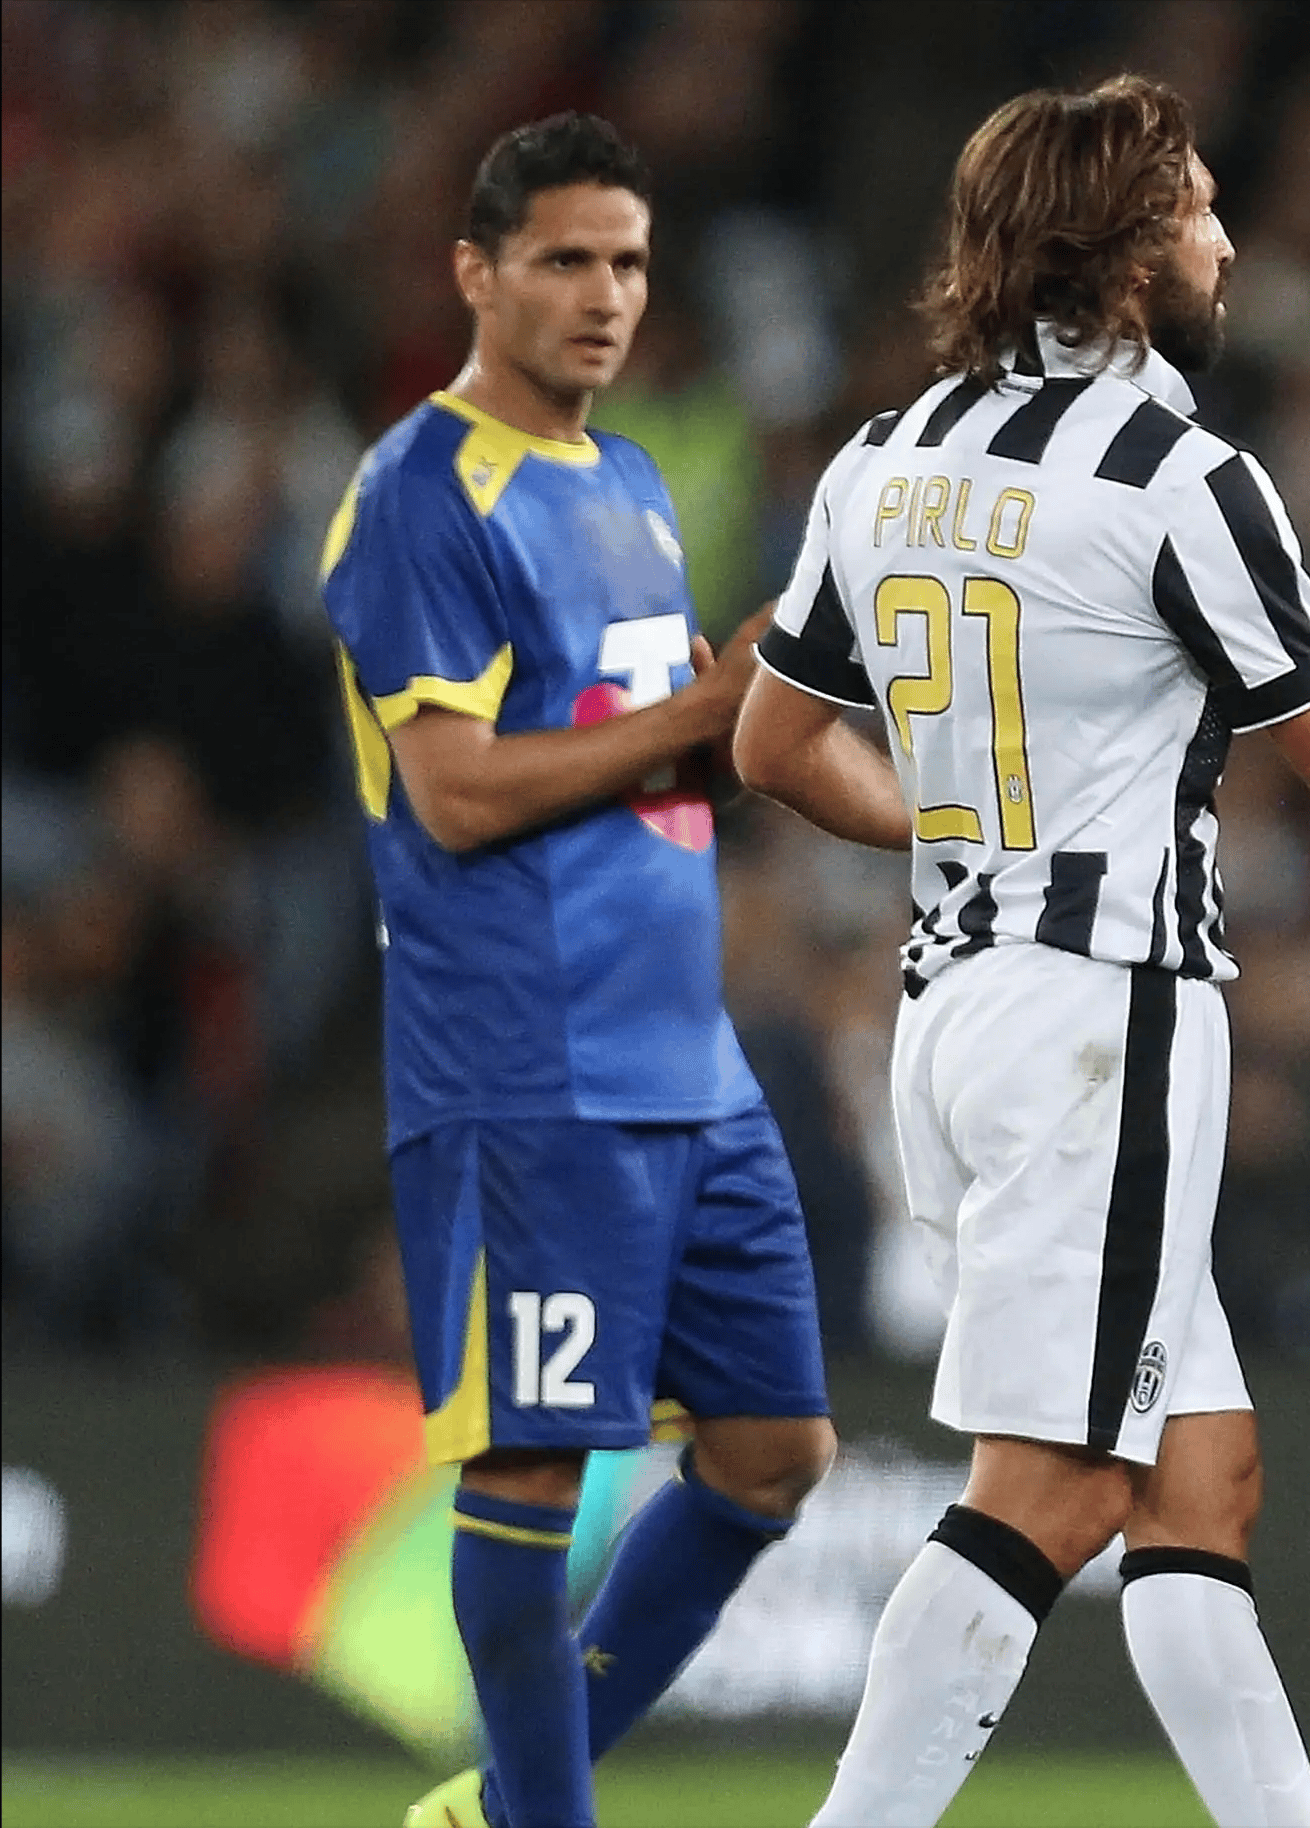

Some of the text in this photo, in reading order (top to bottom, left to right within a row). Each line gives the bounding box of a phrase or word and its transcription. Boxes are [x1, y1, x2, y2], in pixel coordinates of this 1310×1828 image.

[873, 474, 1036, 560] PIRLO
[873, 574, 1038, 852] 21
[508, 1291, 597, 1408] 12
